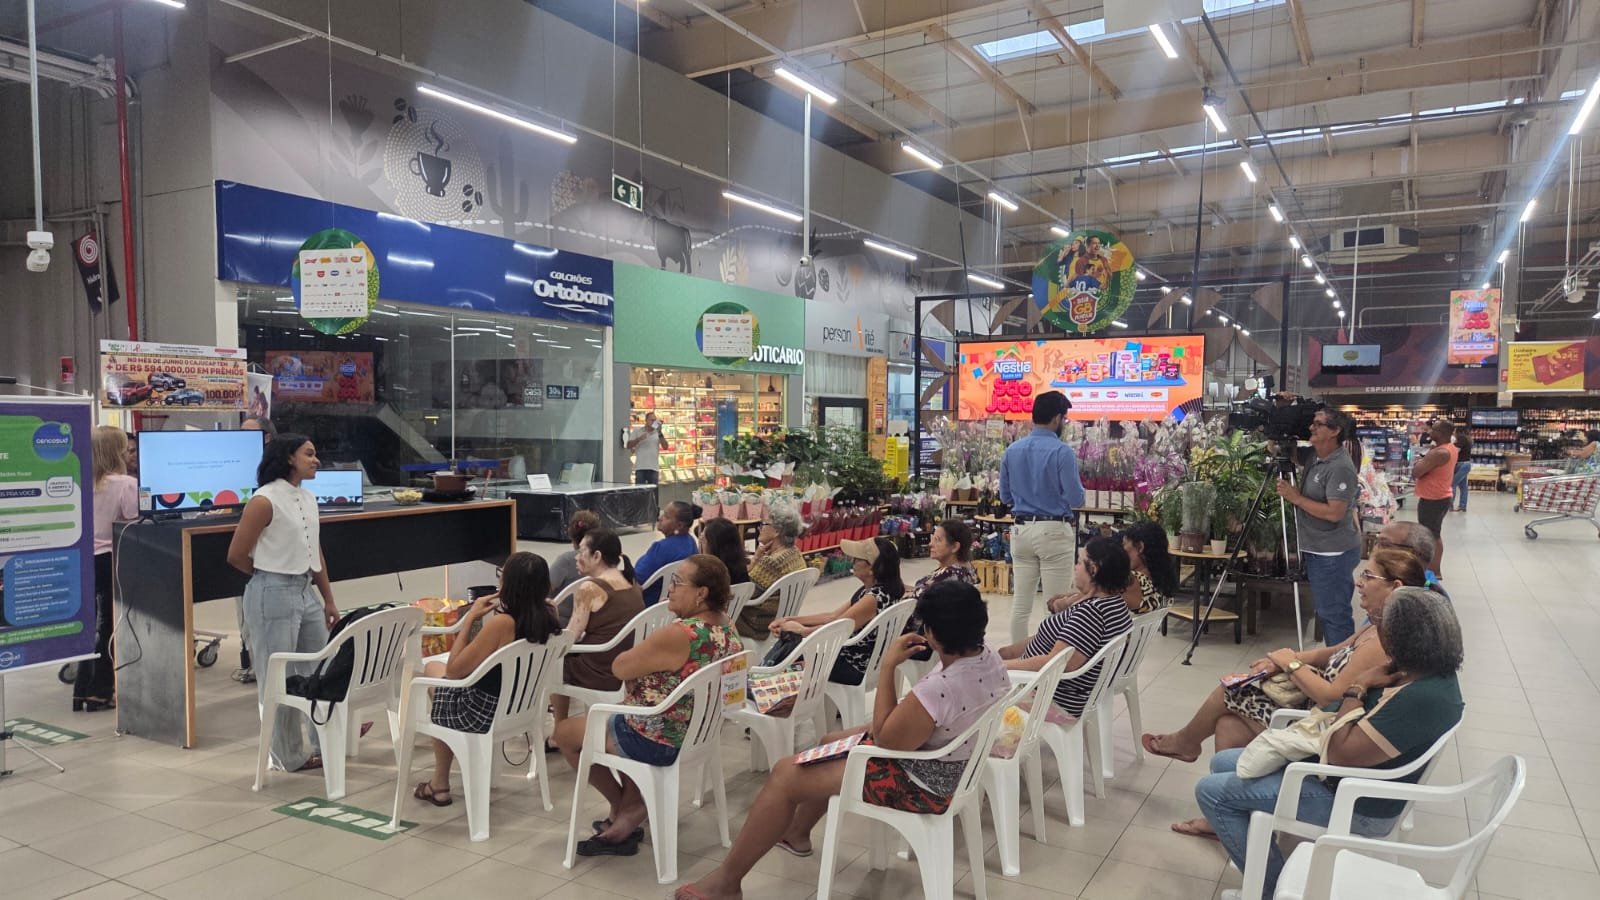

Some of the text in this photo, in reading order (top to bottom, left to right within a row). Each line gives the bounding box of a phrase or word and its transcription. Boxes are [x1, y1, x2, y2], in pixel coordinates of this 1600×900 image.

[549, 270, 593, 285] COLCHÕES
[533, 279, 614, 306] Ortobom
[749, 344, 804, 366] OTICÁRIO
[115, 363, 129, 371] DE
[197, 367, 209, 375] EM
[210, 366, 244, 376] PRÊMIOS
[1365, 385, 1421, 393] ESPUMANTES
